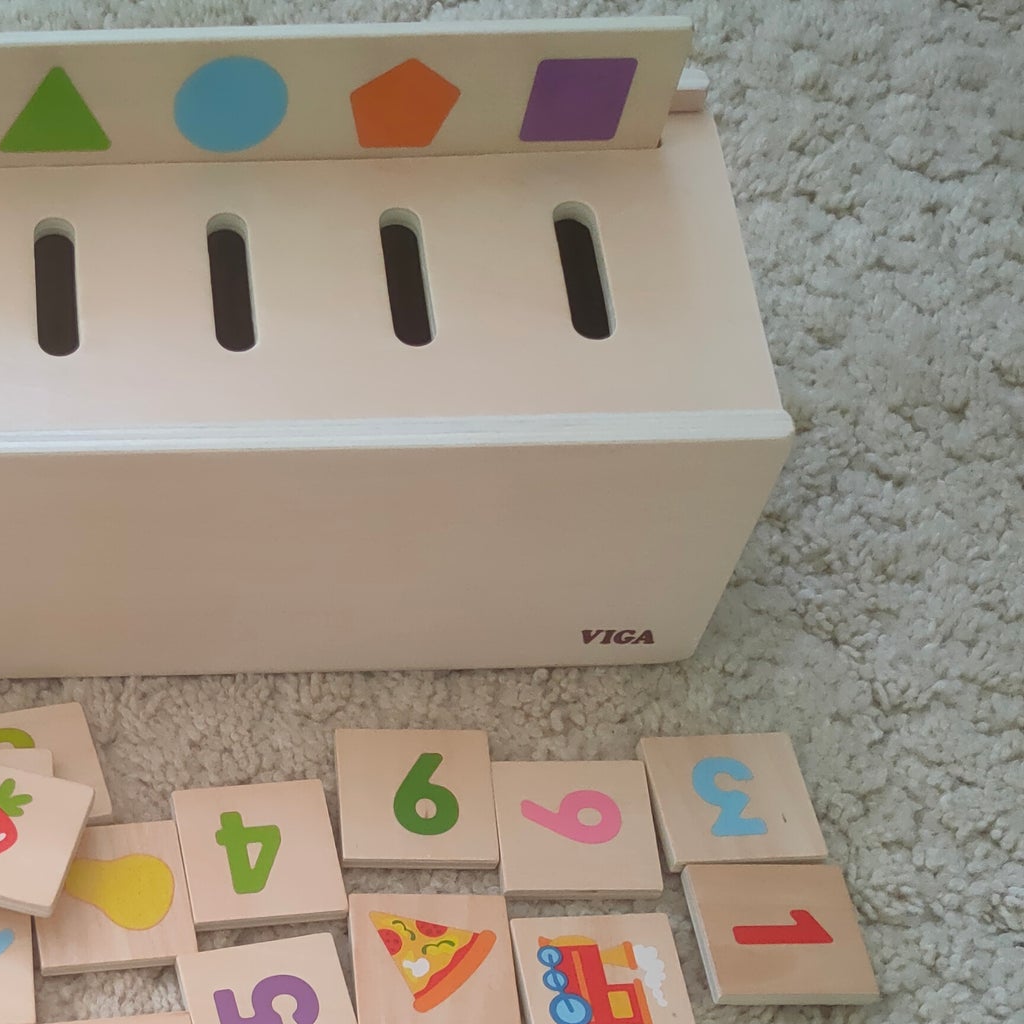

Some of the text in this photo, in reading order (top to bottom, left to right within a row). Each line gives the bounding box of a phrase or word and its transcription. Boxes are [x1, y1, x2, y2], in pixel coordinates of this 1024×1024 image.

[581, 629, 655, 645] VIGA
[692, 757, 768, 837] 3
[215, 811, 281, 894] 4
[732, 909, 833, 945] 1
